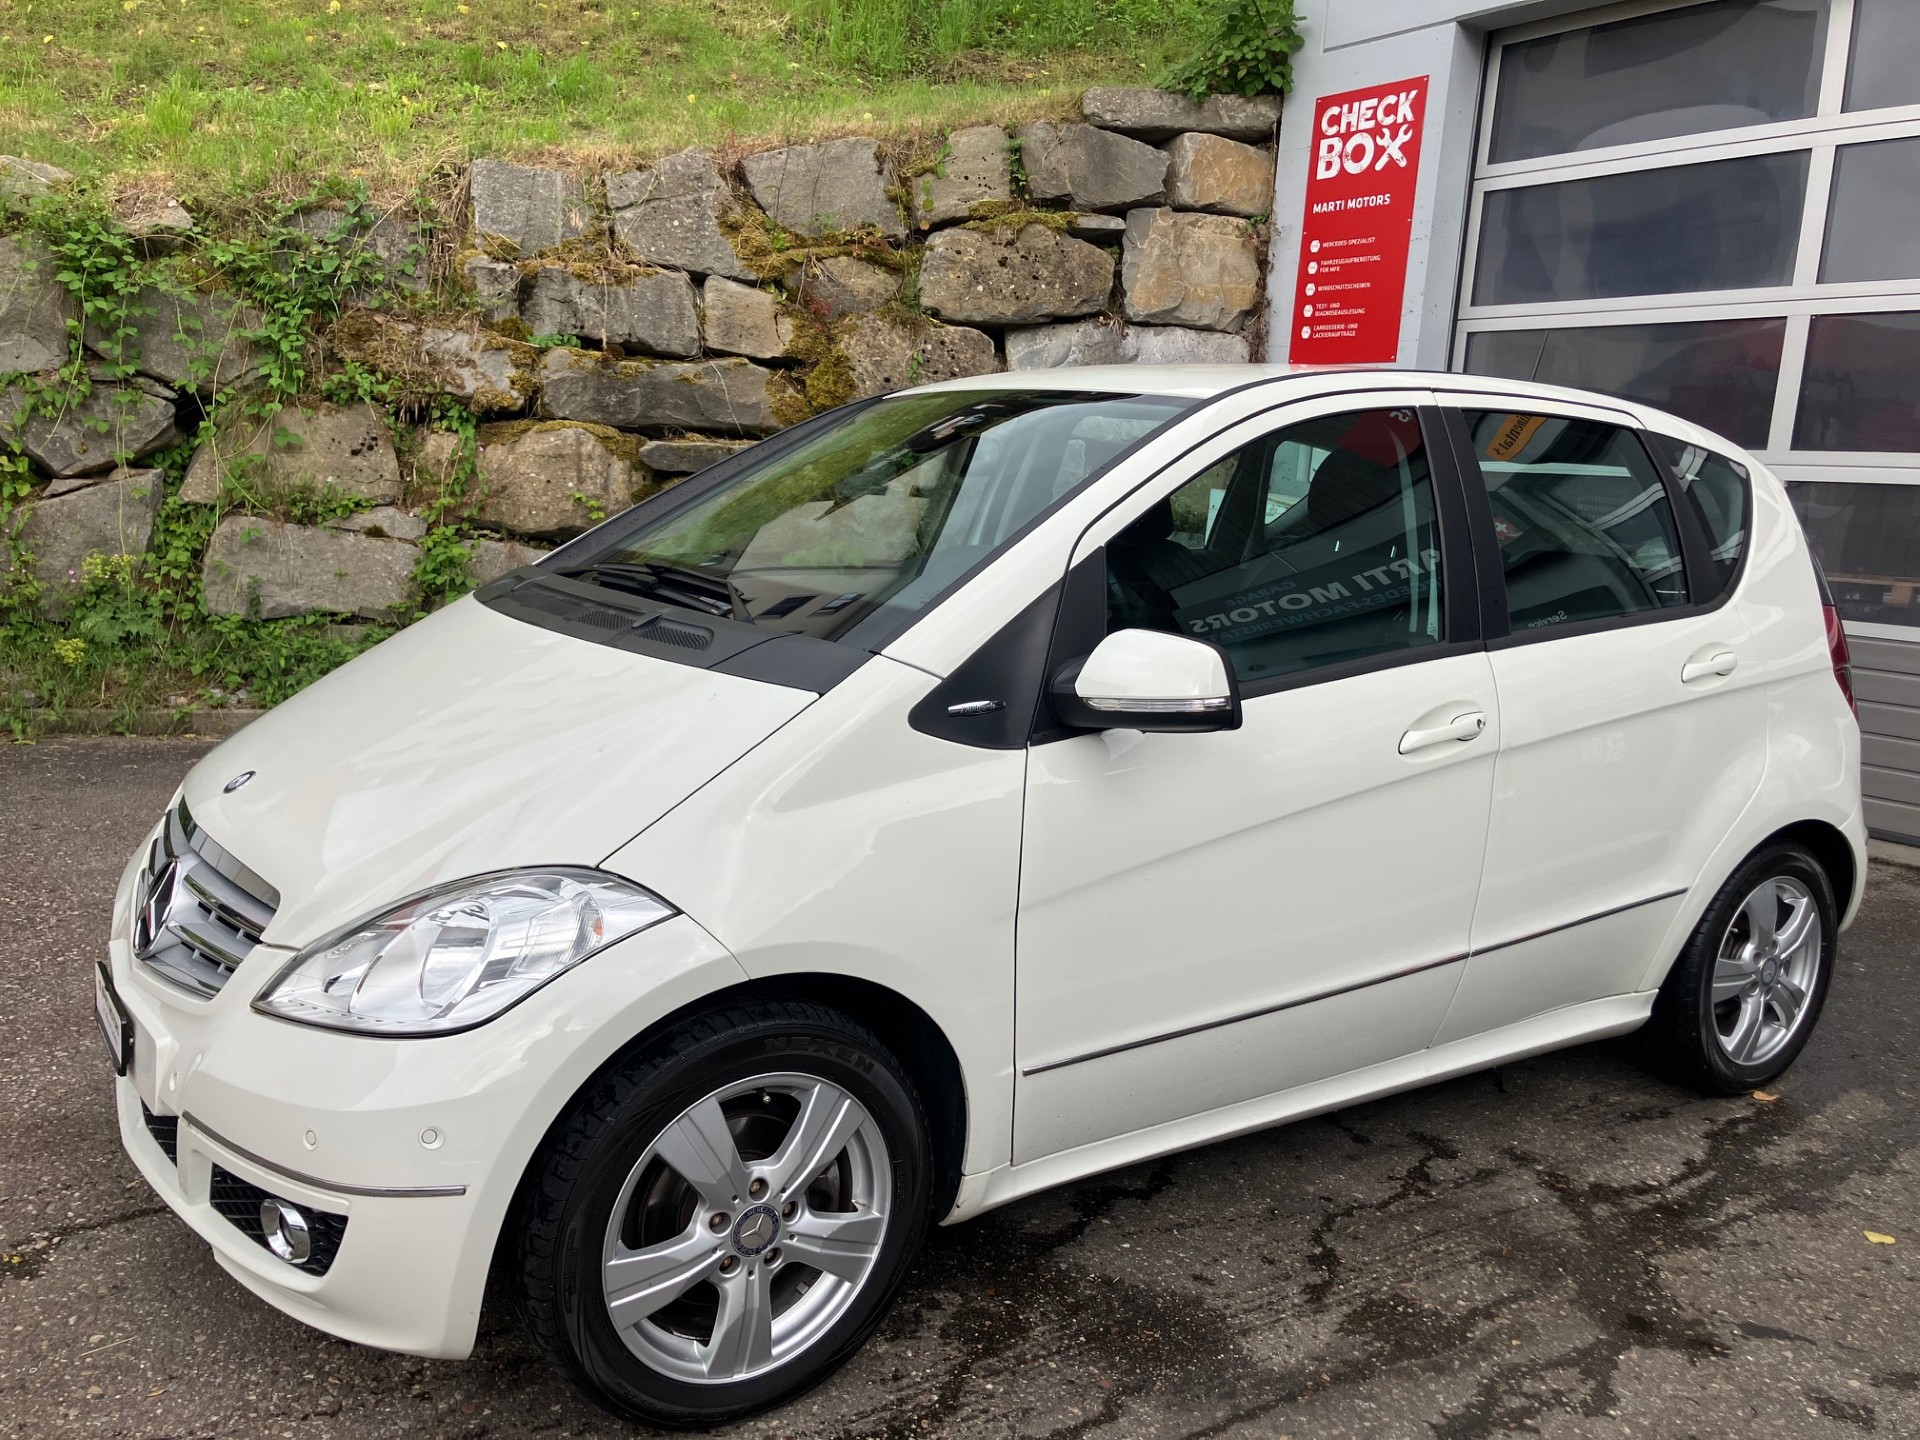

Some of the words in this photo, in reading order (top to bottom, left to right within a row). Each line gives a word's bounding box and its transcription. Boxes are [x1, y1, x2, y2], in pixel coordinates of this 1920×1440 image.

[1321, 89, 1418, 136] CHECK
[1316, 124, 1412, 181] BOX
[1312, 200, 1345, 214] MARTI
[1347, 194, 1391, 209] MOTORS
[1322, 237, 1376, 248] MERCEDES-SPEZIALIST
[1320, 255, 1381, 266] FAHRZEUGAUFBEREITUNG
[1318, 282, 1371, 291] WINDSCHUTZSCHEIBEN
[764, 1036, 875, 1074] NEXEN
